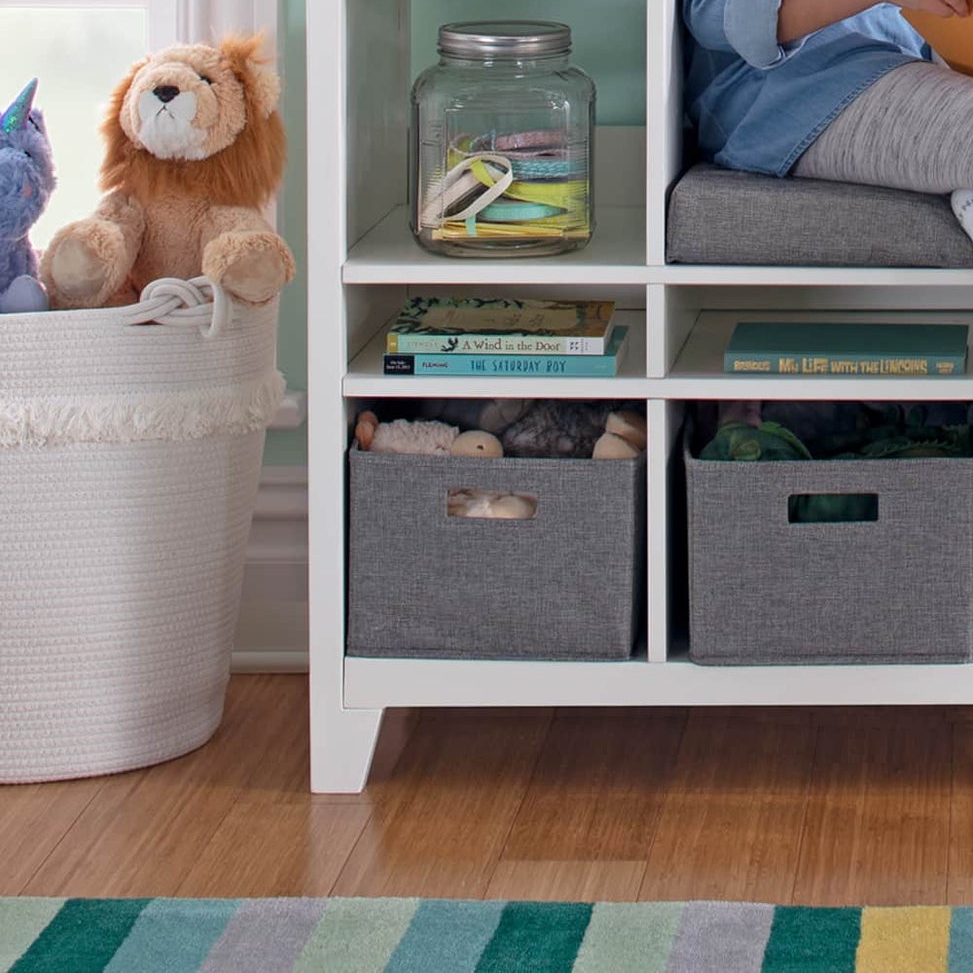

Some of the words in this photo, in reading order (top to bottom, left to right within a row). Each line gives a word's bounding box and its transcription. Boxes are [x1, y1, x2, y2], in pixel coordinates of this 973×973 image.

[463, 340, 471, 350] A
[474, 338, 502, 350] Wind
[506, 340, 514, 351] in
[517, 341, 532, 351] the
[536, 341, 560, 351] Door
[470, 359, 485, 372] THE
[493, 360, 541, 373] SATURDAY
[546, 360, 567, 373] BOY
[831, 360, 858, 374] WITH
[859, 360, 879, 374] THE
